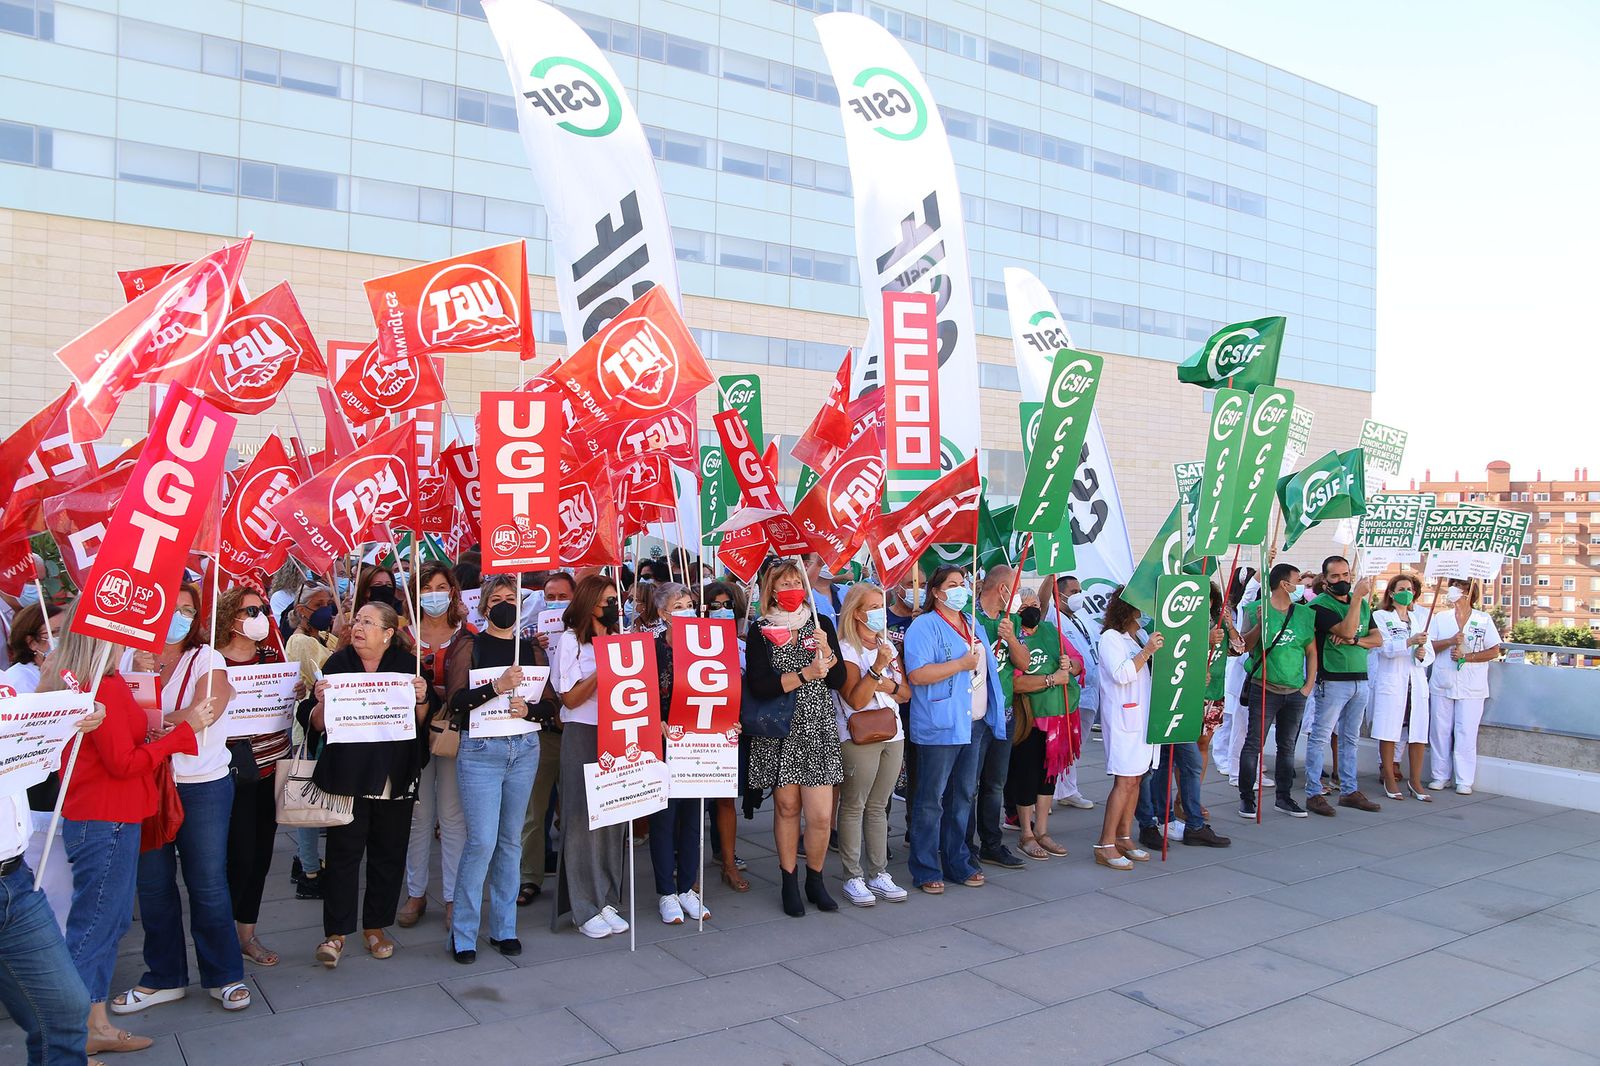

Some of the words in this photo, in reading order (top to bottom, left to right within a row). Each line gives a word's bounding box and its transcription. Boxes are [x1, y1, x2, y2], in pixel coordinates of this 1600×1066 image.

[1217, 344, 1266, 366] CSIF
[893, 301, 931, 464] CCOO
[1061, 373, 1094, 394] CSIF
[729, 389, 756, 404] CSIF
[1219, 409, 1243, 426] CSIF
[1260, 405, 1288, 423] CSIF
[1291, 407, 1314, 429] ATSE
[1364, 422, 1407, 447] SATSE
[1361, 438, 1394, 454] SINDICATO
[1394, 447, 1404, 456] DE
[495, 400, 546, 516] UGT
[723, 415, 775, 510] UGT
[1365, 455, 1400, 476] LMERÍA
[1028, 416, 1073, 525] CSIF
[1176, 464, 1204, 479] SAT
[130, 400, 217, 573] UGT
[1236, 443, 1272, 538] CSIF
[1307, 477, 1341, 512] CSIF
[1204, 447, 1230, 550] CSIF
[1365, 505, 1417, 521] SATSE
[1428, 510, 1498, 526] SATSE
[495, 530, 516, 543] UGT
[1425, 525, 1475, 533] SINDICATO
[1509, 530, 1522, 538] DE
[1357, 535, 1410, 547] ALMERÍA
[1421, 538, 1487, 551] ALMERÍA
[101, 574, 130, 598] UGT
[134, 586, 154, 602] FSP
[1170, 596, 1204, 612] CSIF
[1281, 634, 1296, 643] SI-F
[685, 624, 729, 730] UGT
[1164, 634, 1191, 737] CSIF
[607, 640, 648, 746] UGT
[29, 711, 52, 719] PATADA
[669, 725, 683, 733] UGT
[4, 748, 49, 765] RENOVACIONES
[619, 789, 656, 801] RENOVACIONES
